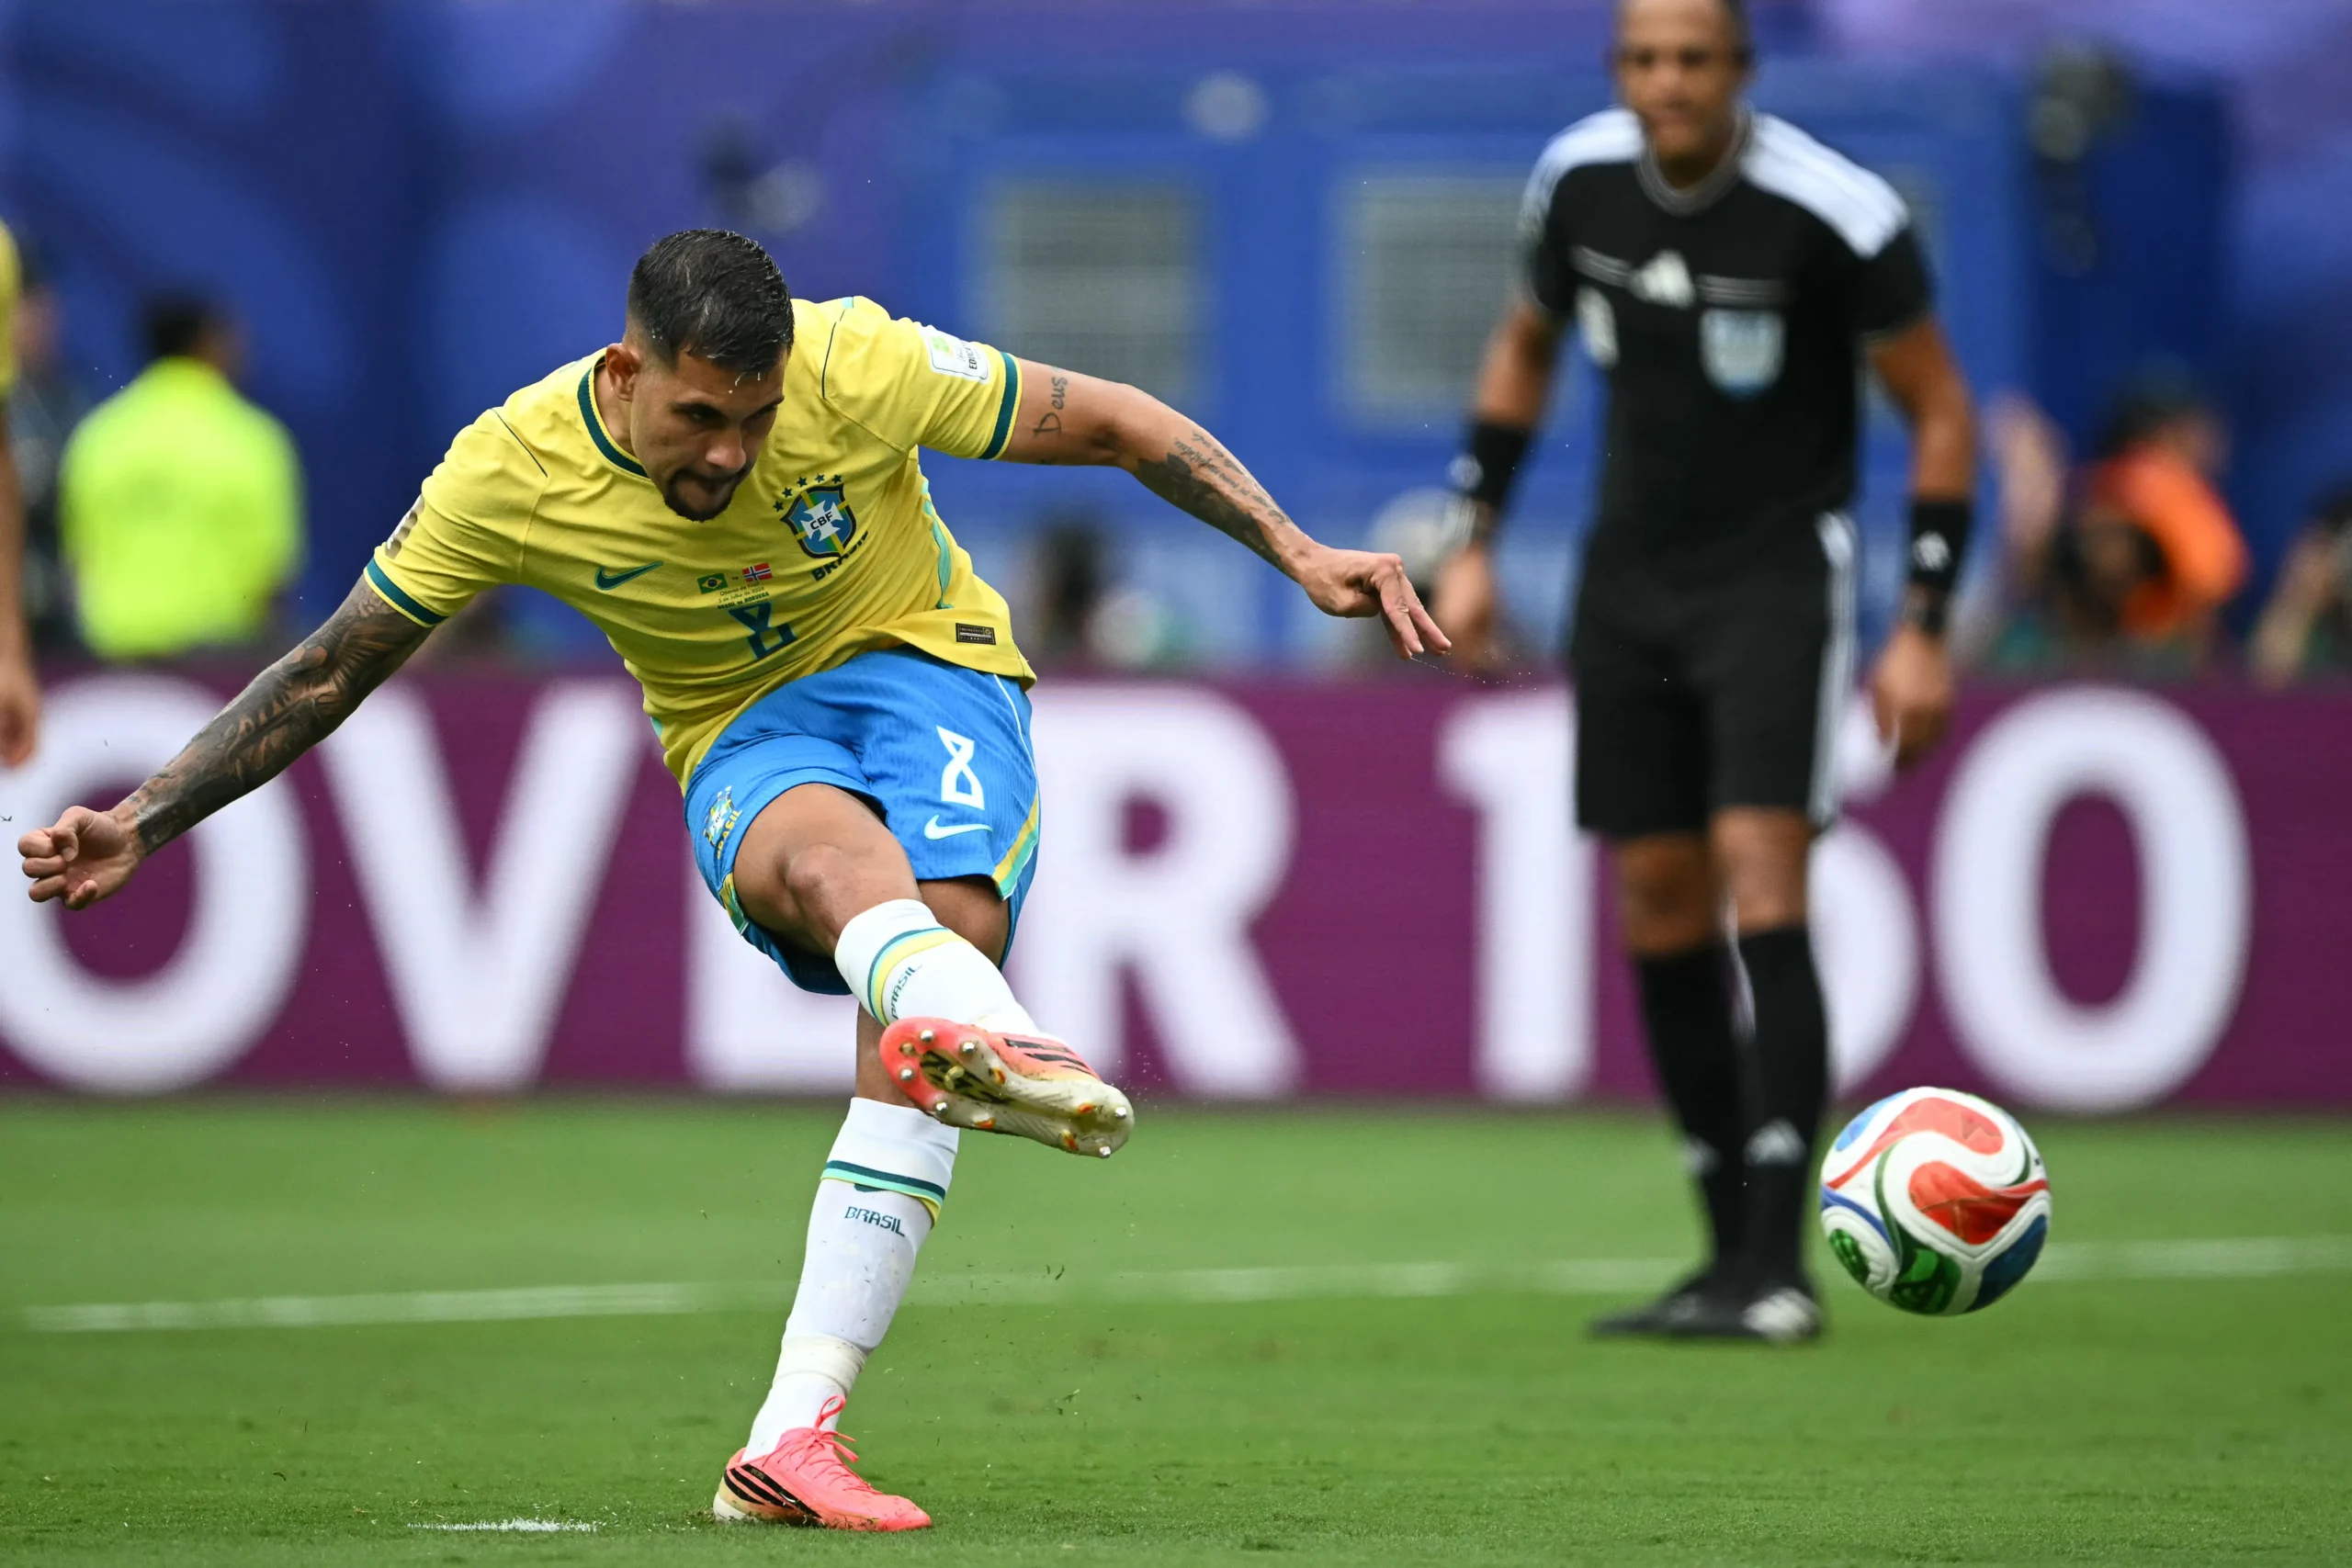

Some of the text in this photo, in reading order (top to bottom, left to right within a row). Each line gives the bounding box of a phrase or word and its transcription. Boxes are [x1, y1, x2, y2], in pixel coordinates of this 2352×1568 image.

[1033, 376, 1069, 437] Deus
[809, 511, 833, 531] CBF
[728, 601, 797, 660] 8
[936, 725, 985, 811] 8
[844, 1205, 905, 1237] BRASIL
